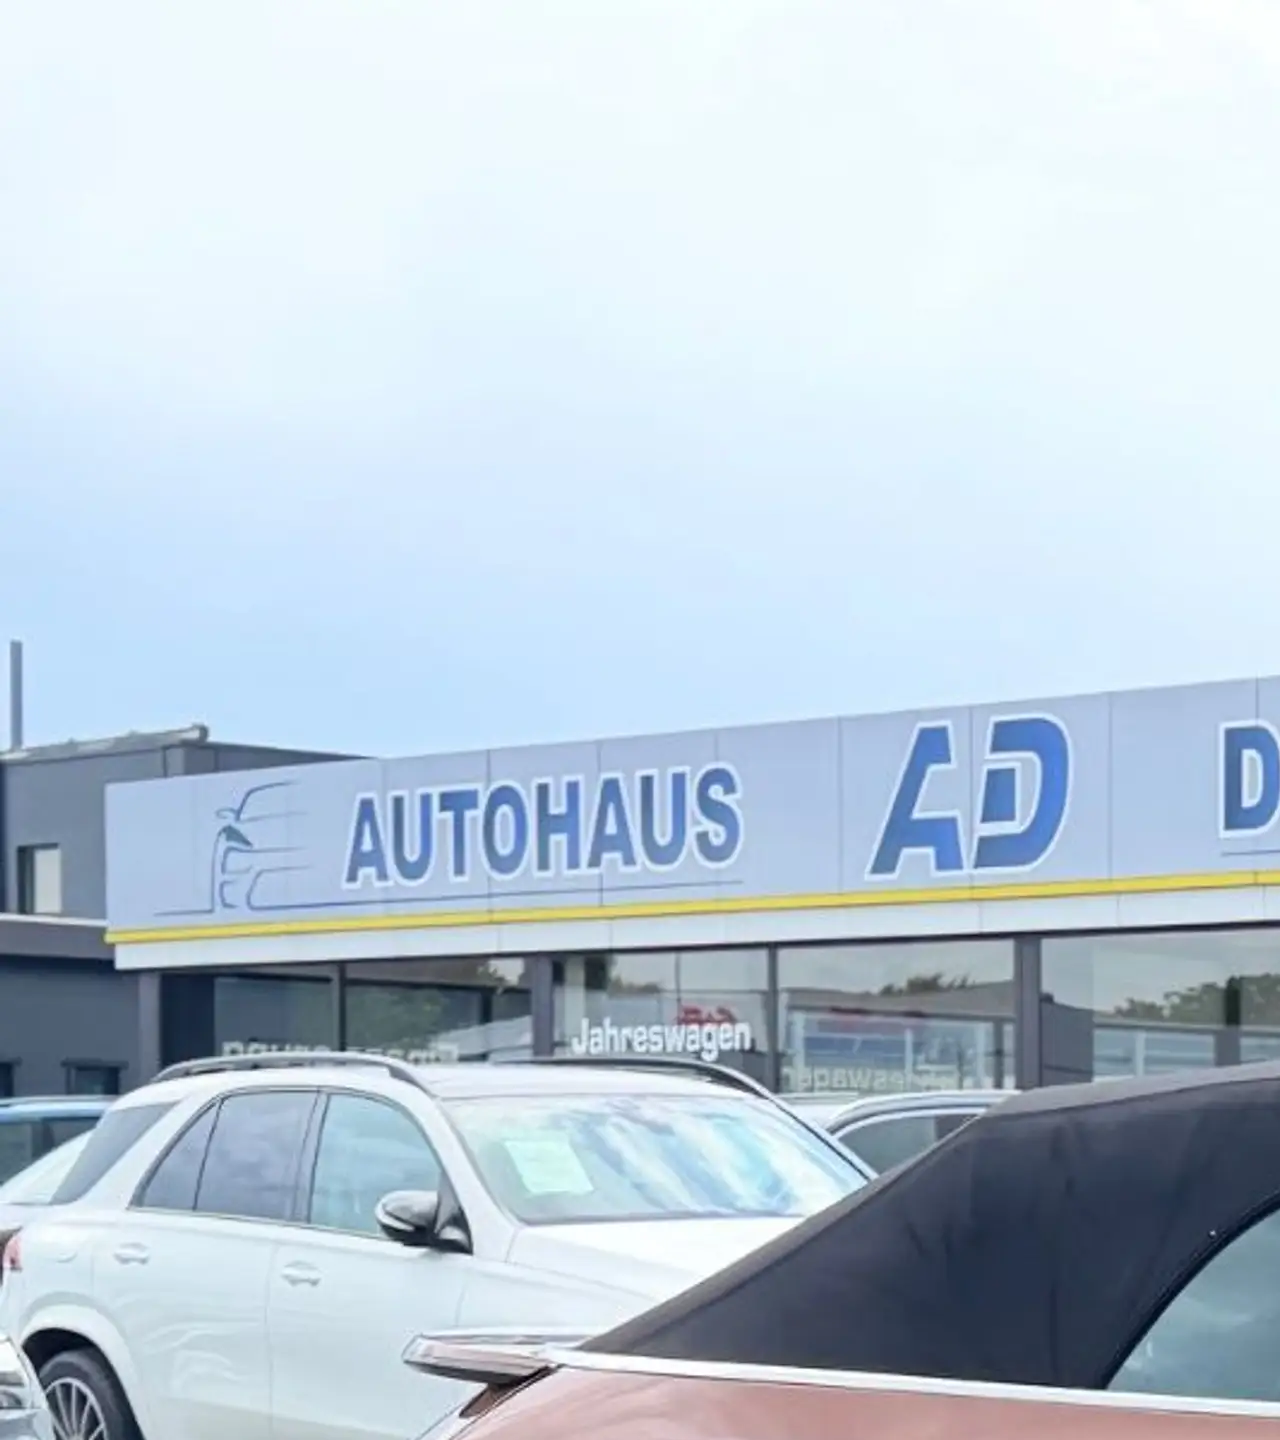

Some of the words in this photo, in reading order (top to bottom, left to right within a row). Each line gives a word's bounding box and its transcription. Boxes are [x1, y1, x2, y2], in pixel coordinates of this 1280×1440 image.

[343, 763, 742, 889] AUTOHAUS
[865, 713, 1073, 880] AD
[572, 1015, 751, 1062] Jahreswagen
